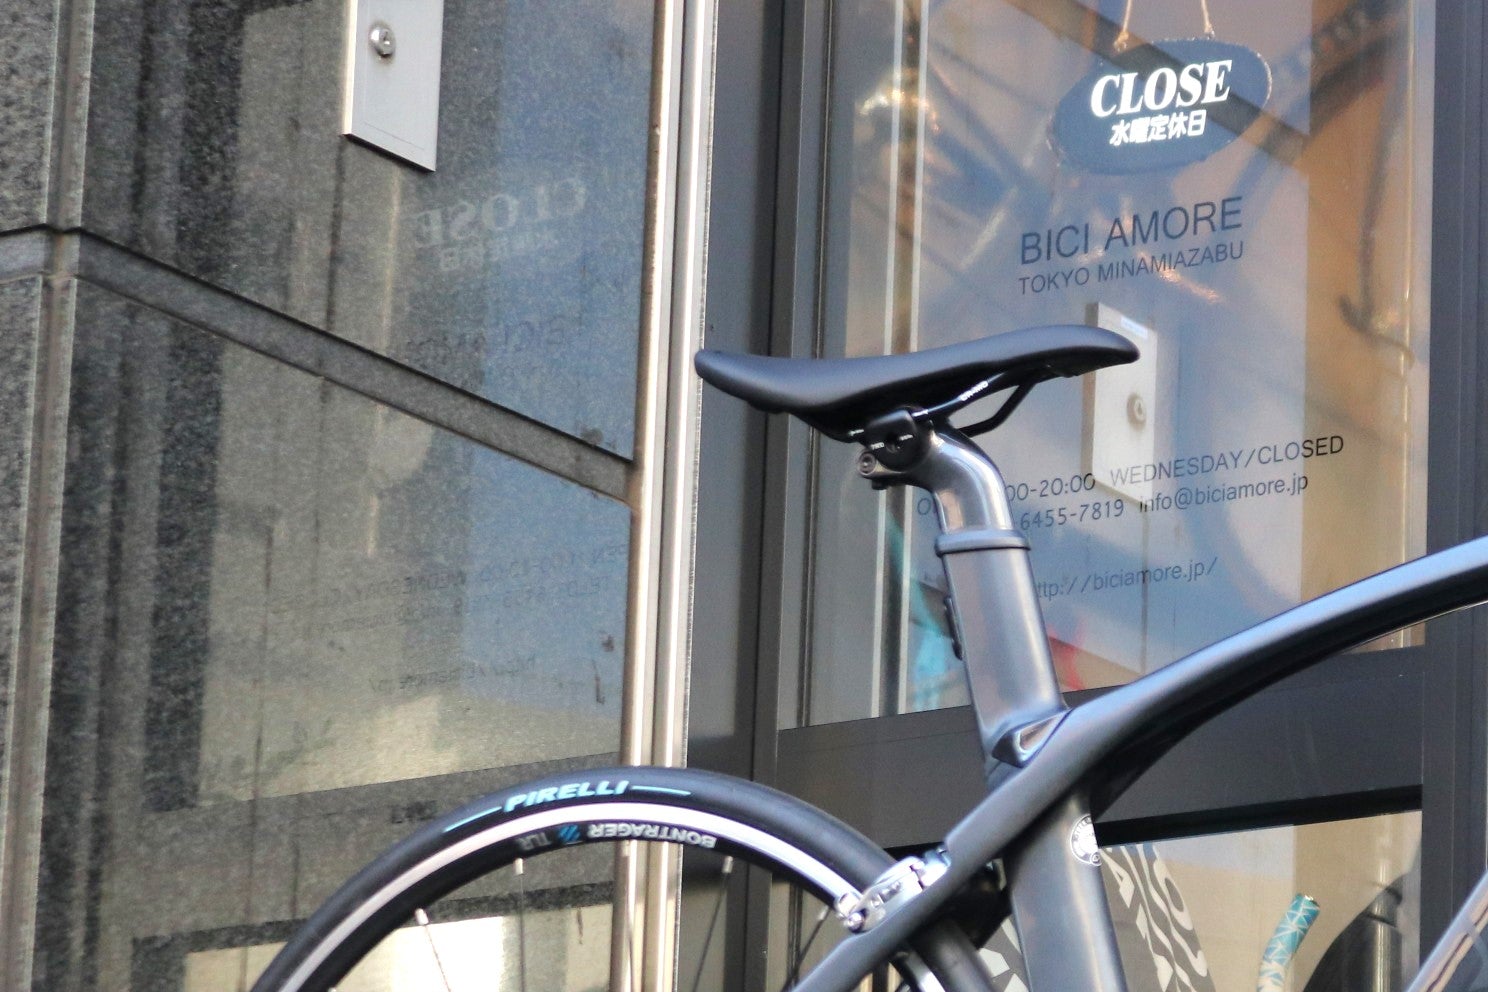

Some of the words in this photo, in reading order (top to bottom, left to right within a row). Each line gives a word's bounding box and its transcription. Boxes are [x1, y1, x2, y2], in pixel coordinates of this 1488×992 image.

[1090, 59, 1232, 117] CLOSE
[1110, 109, 1206, 146] 水曜定休日
[1021, 223, 1090, 265] BICI
[1104, 196, 1243, 251] AMORE
[1019, 266, 1090, 295] TOKYO
[1098, 241, 1244, 283] MINAMIAZABU
[1110, 435, 1344, 487] WEDNESDAY/CLOSED
[1139, 473, 1308, 514] info@biciamore.jp
[503, 780, 630, 813] PIRELLI
[516, 831, 551, 850] TLR
[587, 822, 718, 849] BONTRAGER
